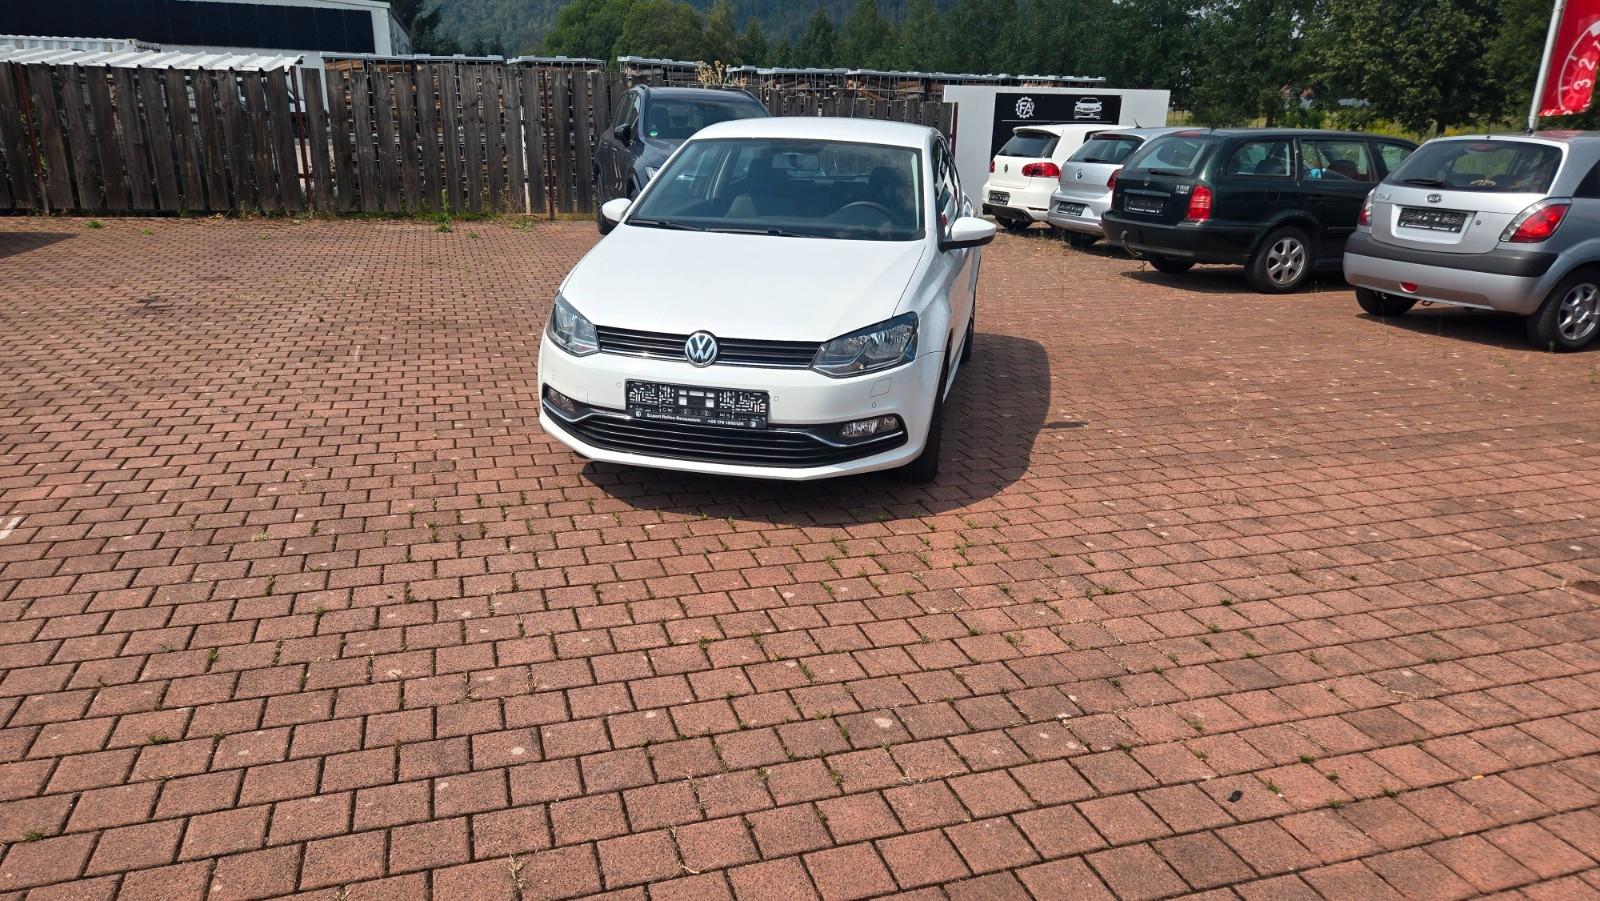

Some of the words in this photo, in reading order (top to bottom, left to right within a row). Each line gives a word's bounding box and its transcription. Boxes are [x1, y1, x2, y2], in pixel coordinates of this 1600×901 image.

[1578, 58, 1595, 71] 2
[1573, 79, 1591, 90] 3
[686, 333, 717, 364] VW
